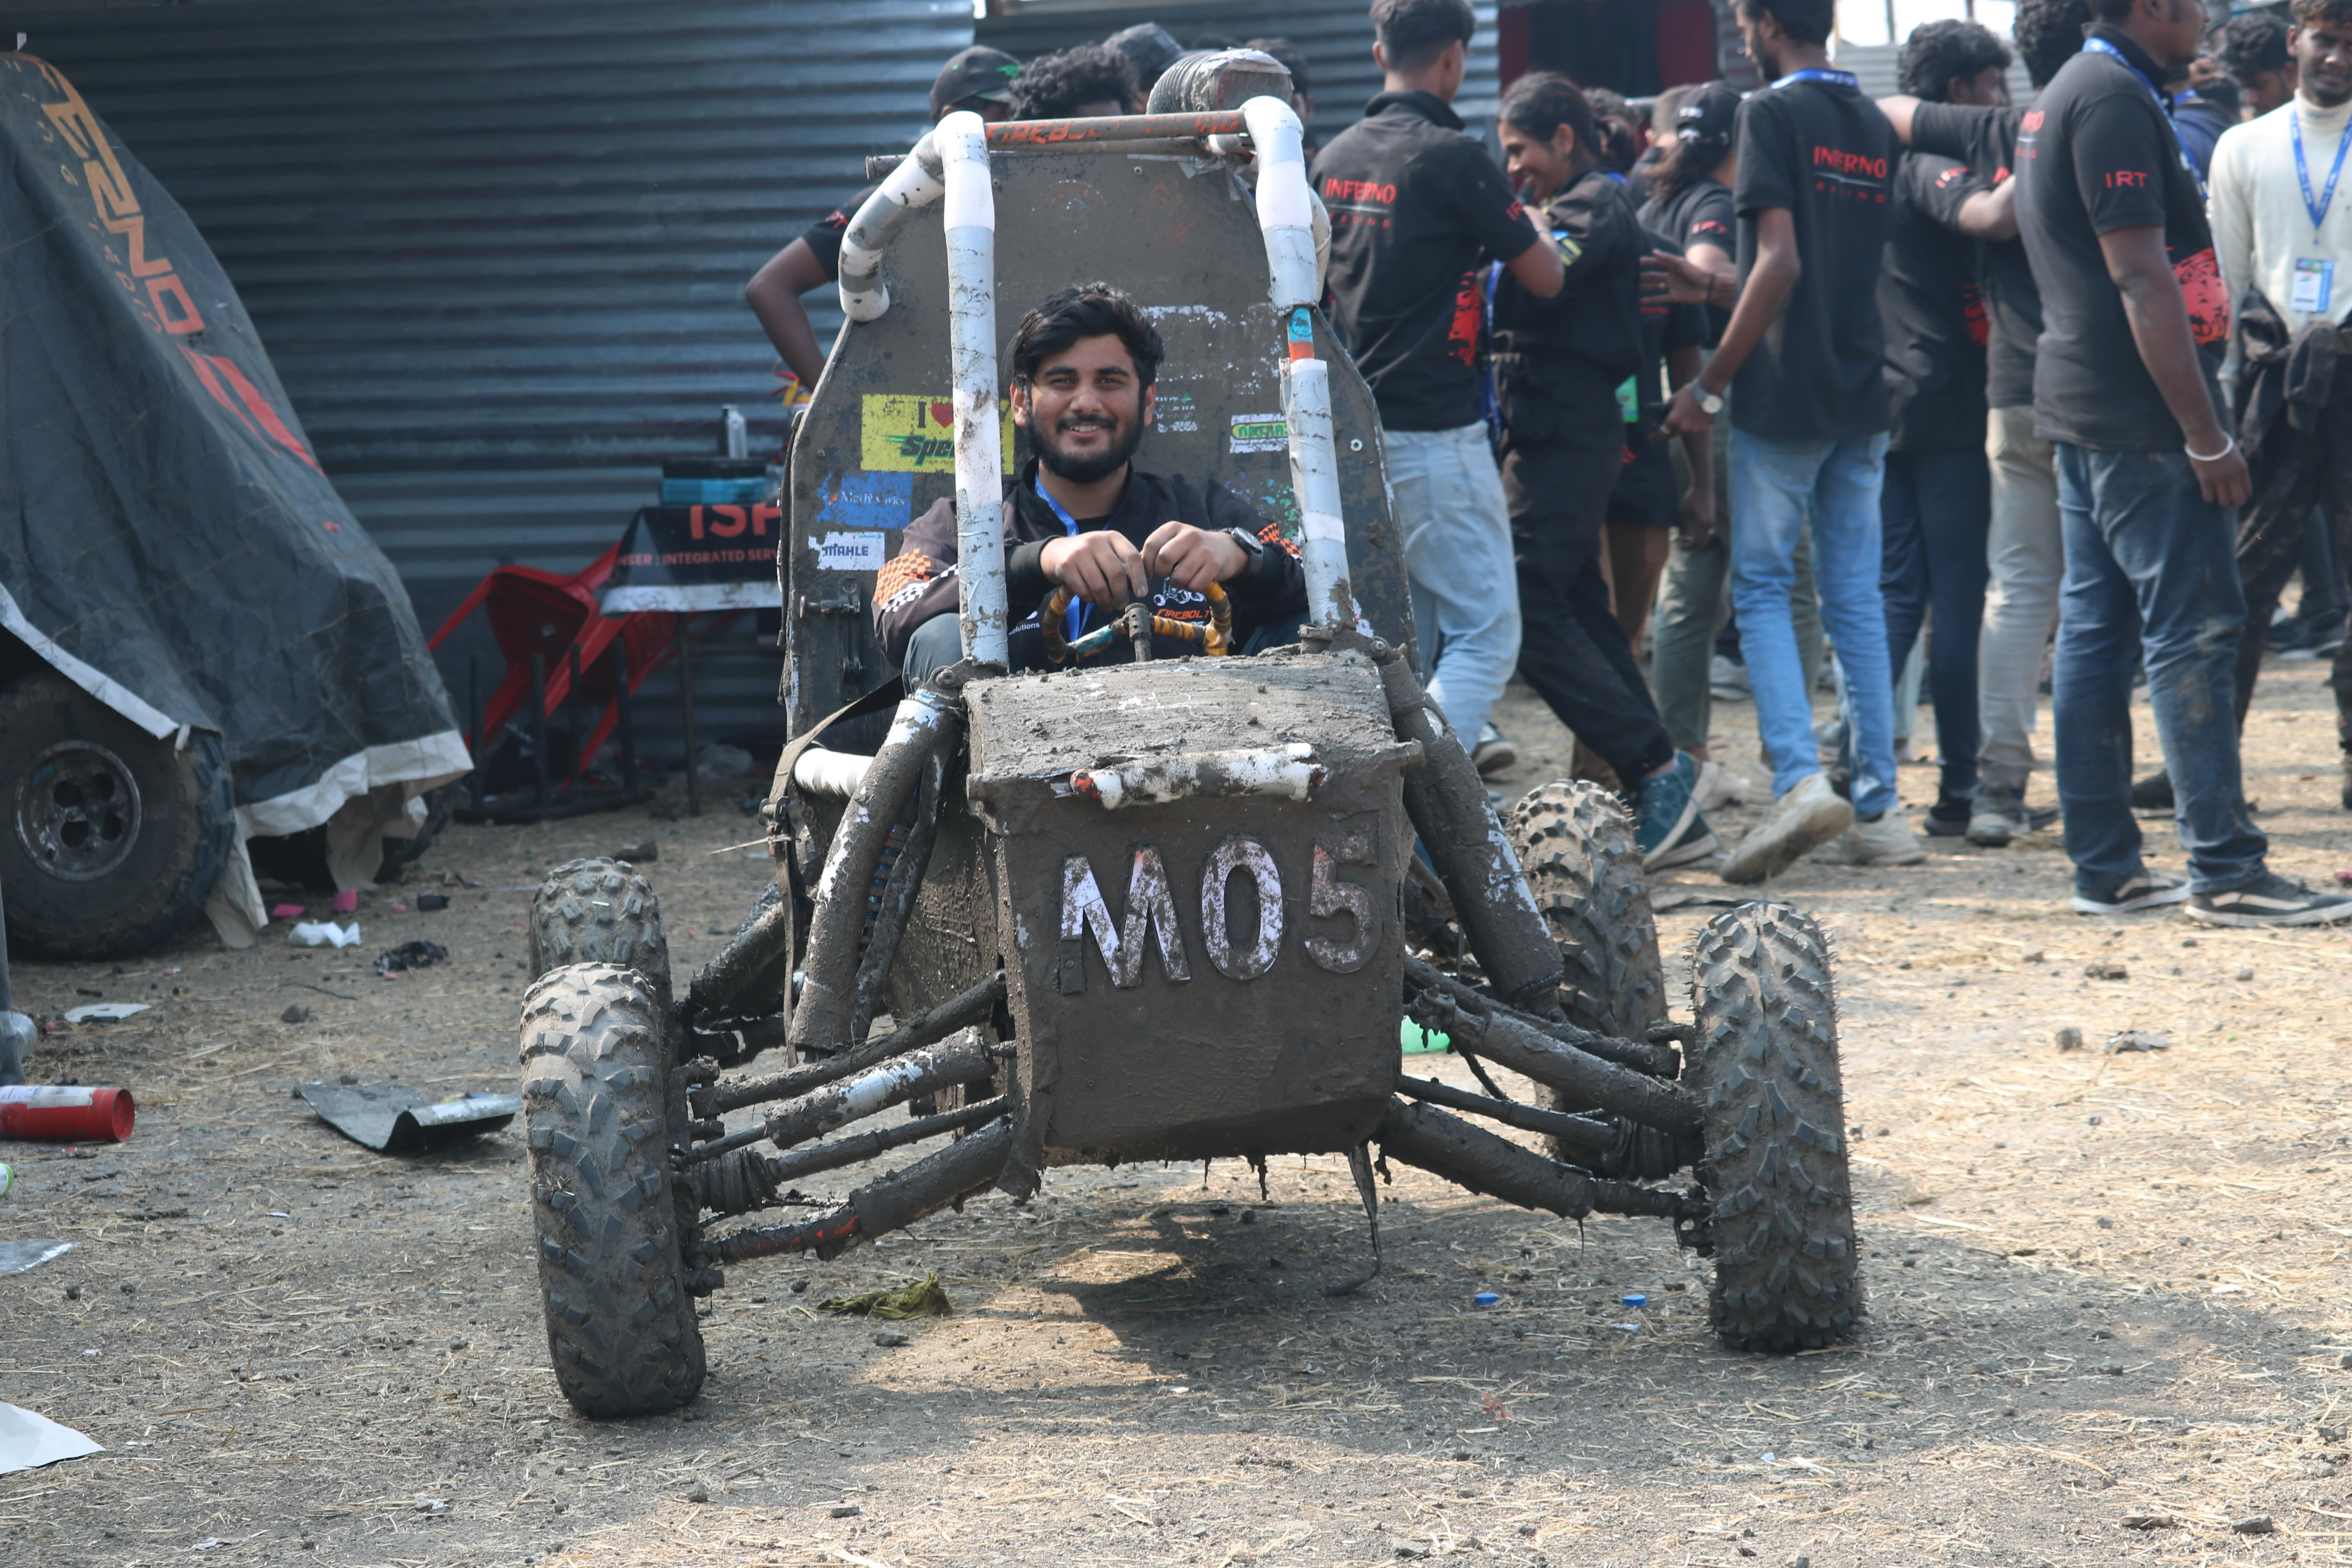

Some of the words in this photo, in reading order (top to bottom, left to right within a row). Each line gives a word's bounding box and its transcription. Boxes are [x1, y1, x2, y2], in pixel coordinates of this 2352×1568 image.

[2105, 170, 2148, 189] IRT
[16, 52, 205, 334] FERNO
[1326, 178, 1396, 204] INFERNO
[917, 401, 927, 428] I
[617, 553, 652, 566] NSER
[662, 550, 745, 565] INTEGRATED
[824, 546, 869, 556] MAHLE
[1157, 609, 1210, 620] FIREBOLT
